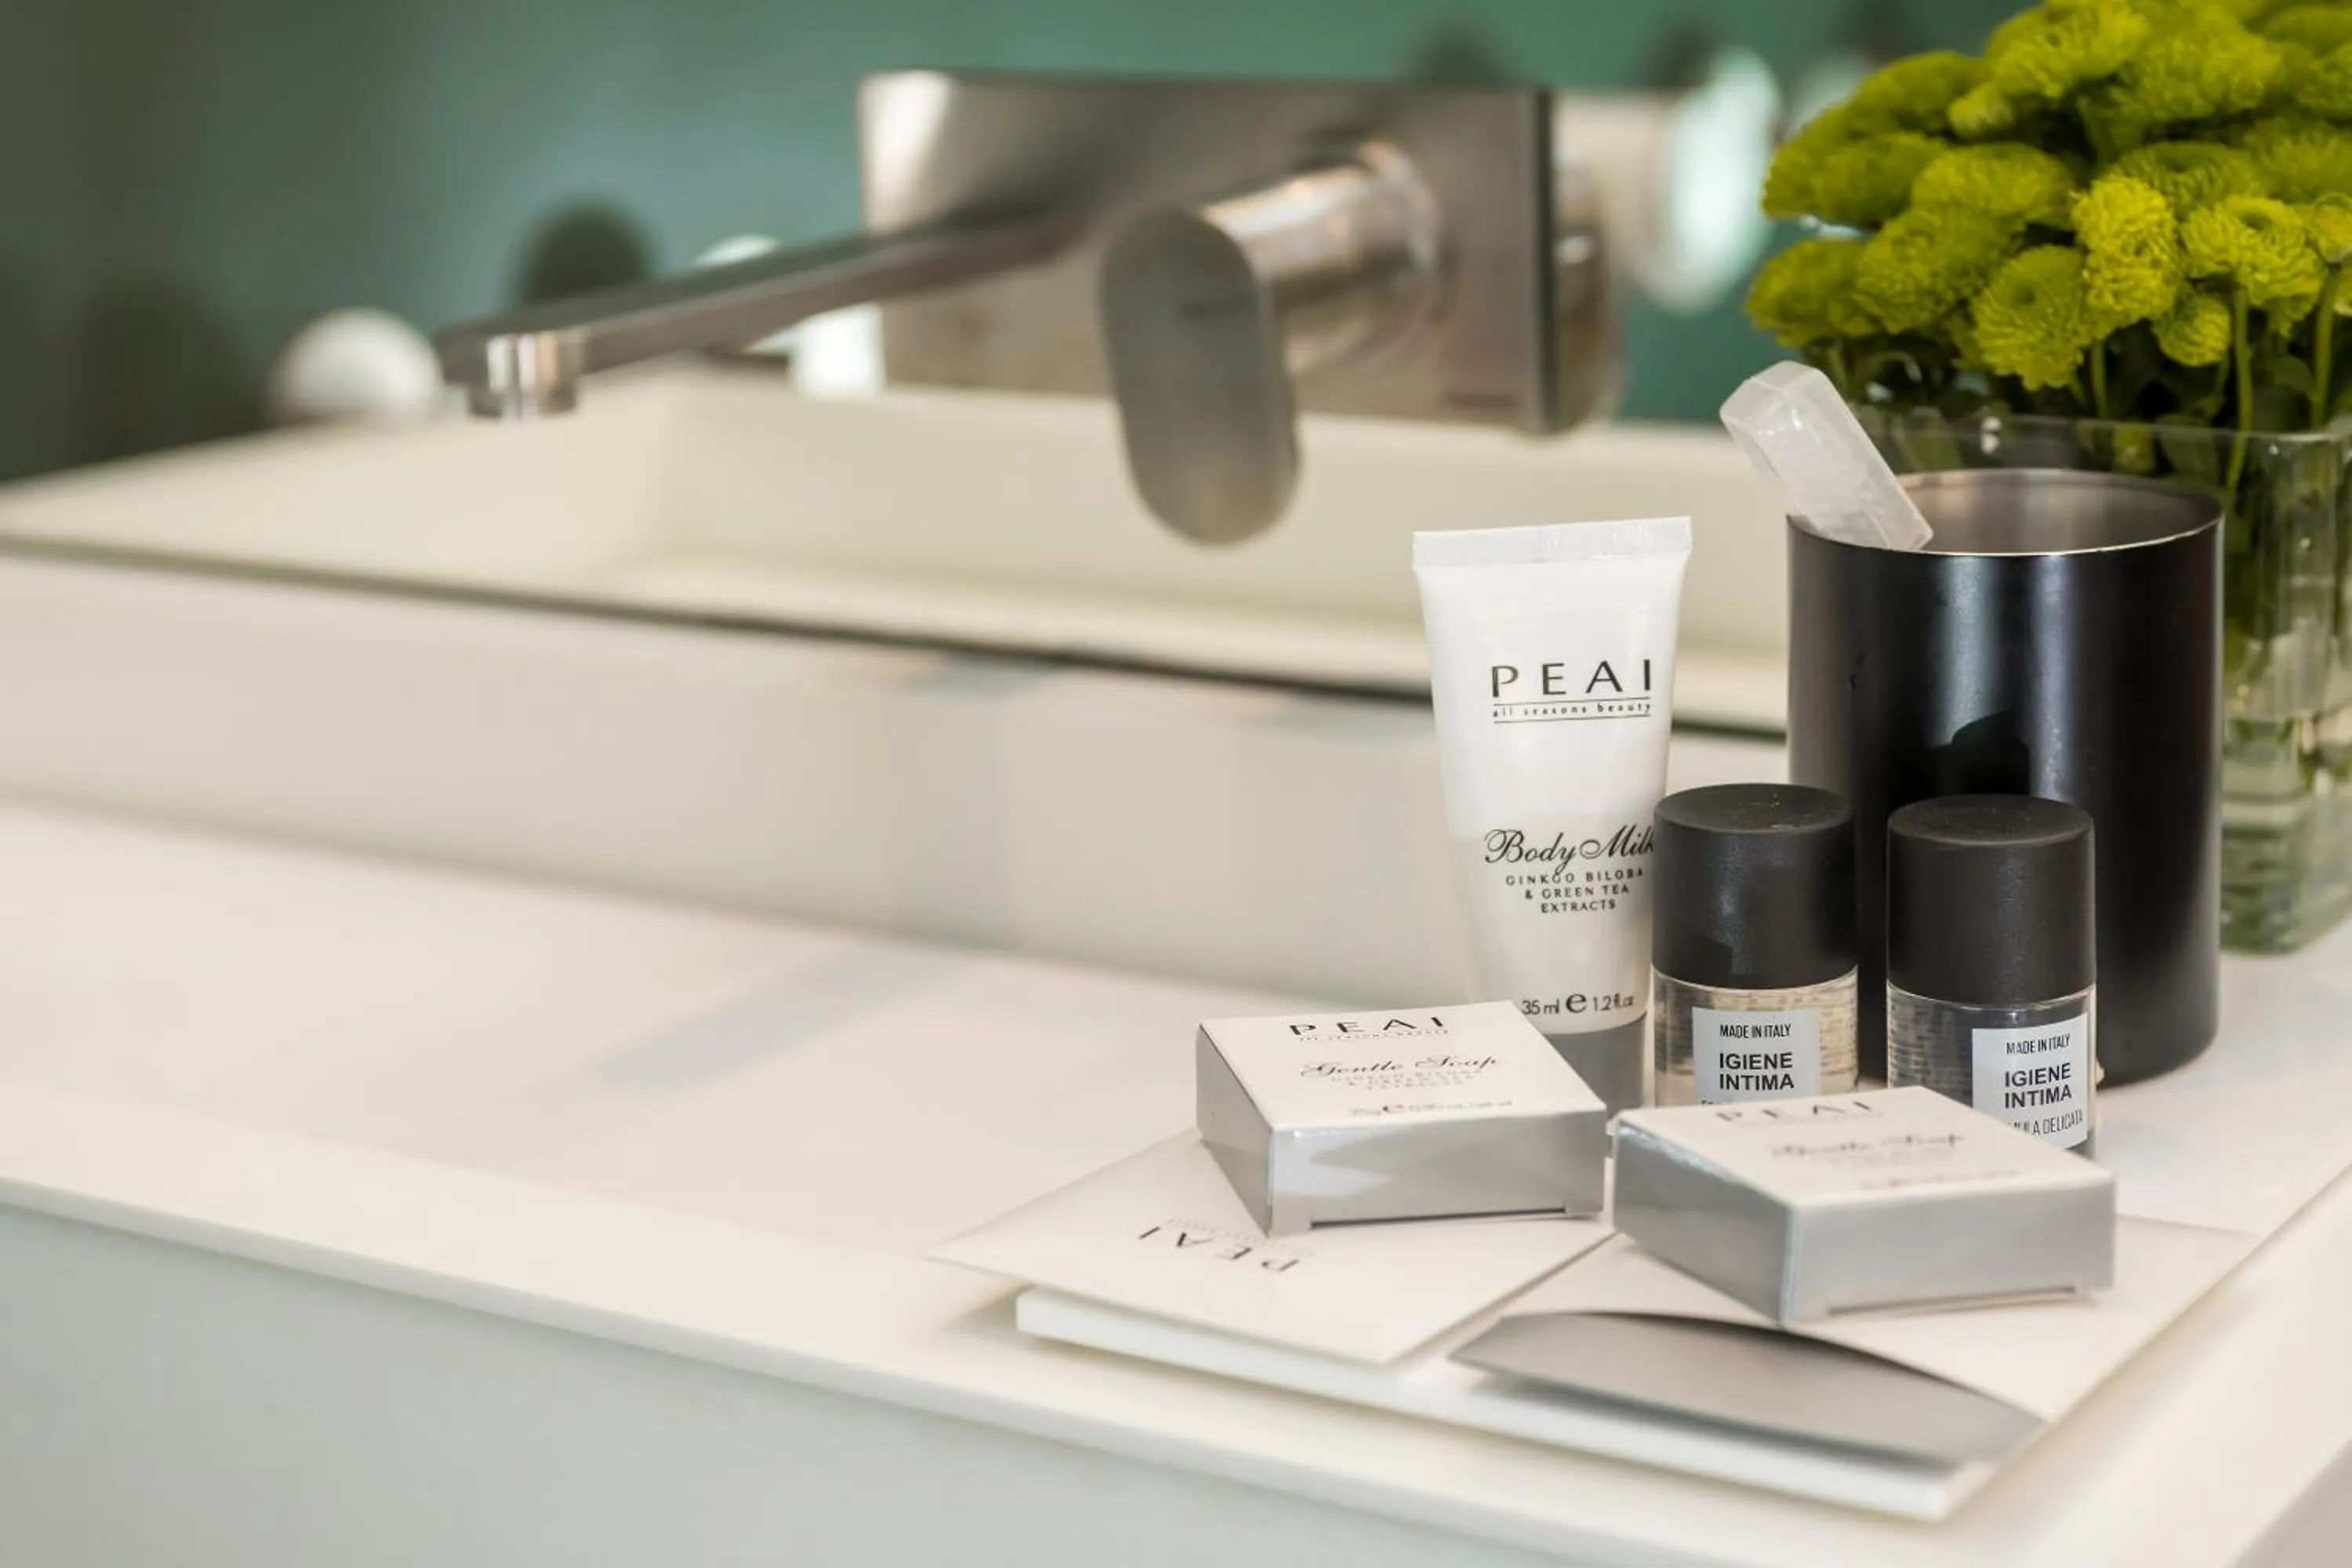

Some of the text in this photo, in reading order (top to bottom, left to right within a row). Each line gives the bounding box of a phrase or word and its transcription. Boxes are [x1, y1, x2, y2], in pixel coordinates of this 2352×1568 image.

[1491, 659, 1651, 698] PEAI
[1492, 702, 1651, 717] all seasons beauty
[1484, 823, 1655, 876] Body Milk
[1505, 867, 1644, 886] GINKGO BILOBA
[1525, 884, 1630, 899] & GREEN TEA
[1541, 899, 1616, 913] EXTRACTS
[1290, 1017, 1443, 1035] PEAI
[1719, 1023, 1791, 1038] MADE IN ITALY
[2006, 1033, 2071, 1055] MADE IN ITALY
[1719, 1052, 1793, 1070] IGIENE
[1719, 1073, 1795, 1091] INTIMA
[2005, 1062, 2071, 1087] IGIENE
[2005, 1084, 2072, 1109] INTIMA
